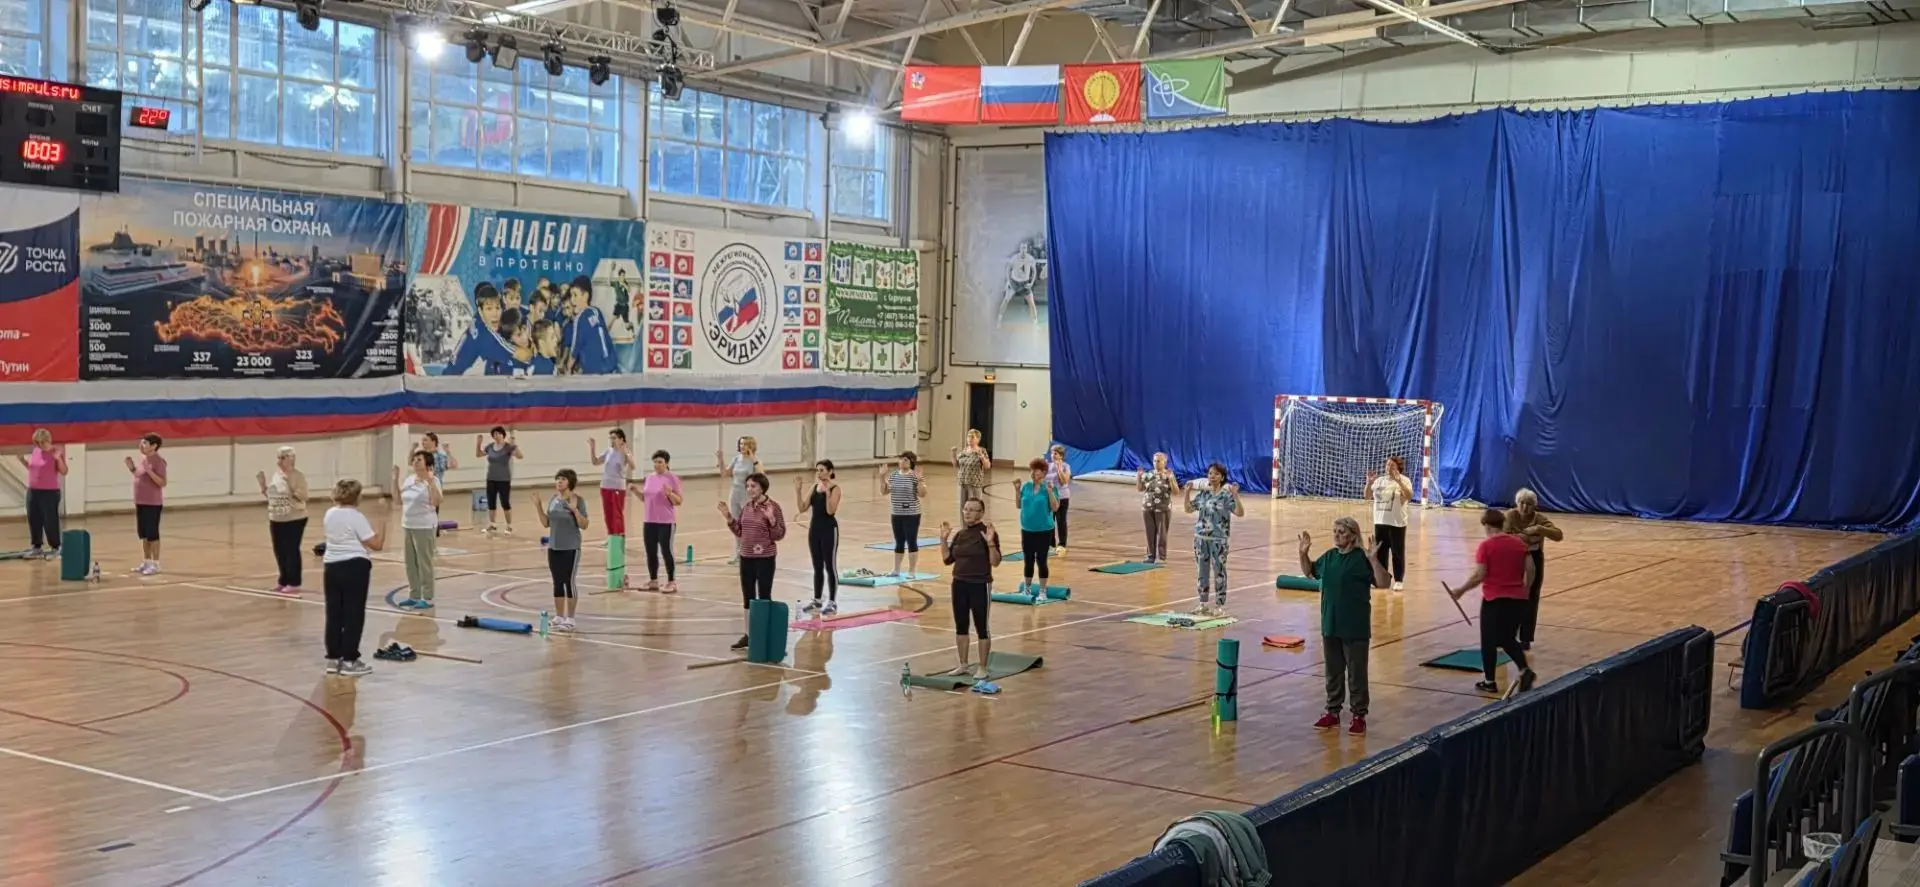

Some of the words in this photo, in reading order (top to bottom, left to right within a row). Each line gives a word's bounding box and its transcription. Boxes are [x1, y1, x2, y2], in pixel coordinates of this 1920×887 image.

[23, 141, 60, 161] 10:03
[193, 192, 315, 216] СПЕЦИАЛЬНАЯ
[173, 211, 267, 232] ПОЖАРНАЯ
[271, 218, 332, 237] ОХРАНА
[479, 216, 588, 256] ГАНДБОЛ
[26, 247, 66, 260] ТОЧКА
[26, 260, 66, 273] РОСТА
[479, 256, 486, 266] В
[495, 257, 584, 272] ПРОТВИНО
[89, 322, 112, 331] 3000
[709, 324, 767, 362] ЭРИДАН
[193, 351, 212, 362] 337
[236, 356, 249, 366] 23
[295, 350, 313, 360] 323
